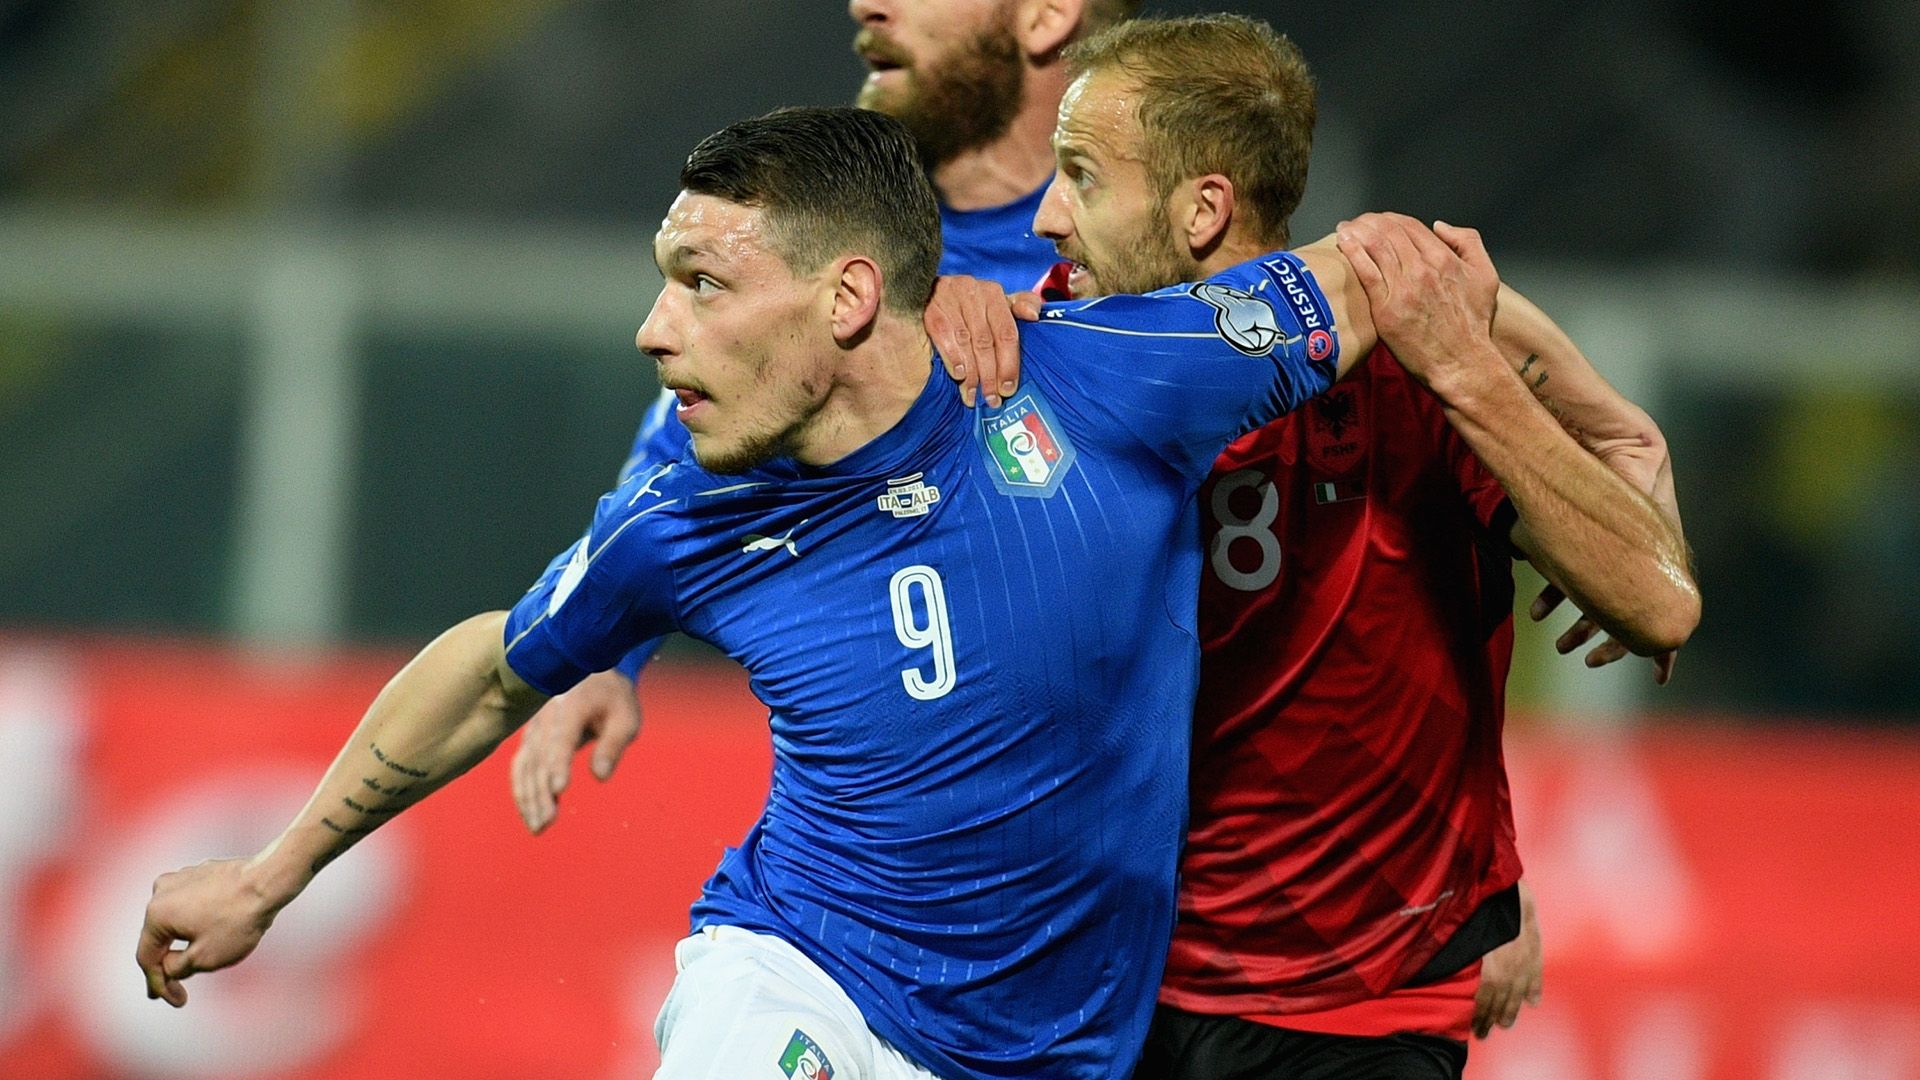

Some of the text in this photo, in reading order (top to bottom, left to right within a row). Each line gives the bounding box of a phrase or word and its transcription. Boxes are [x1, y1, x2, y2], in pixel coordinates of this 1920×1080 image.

[1264, 259, 1320, 328] RESPECT
[987, 407, 1028, 434] ITALIA
[1211, 469, 1281, 591] 8
[889, 565, 956, 700] 9
[800, 1034, 830, 1073] ITALIA
